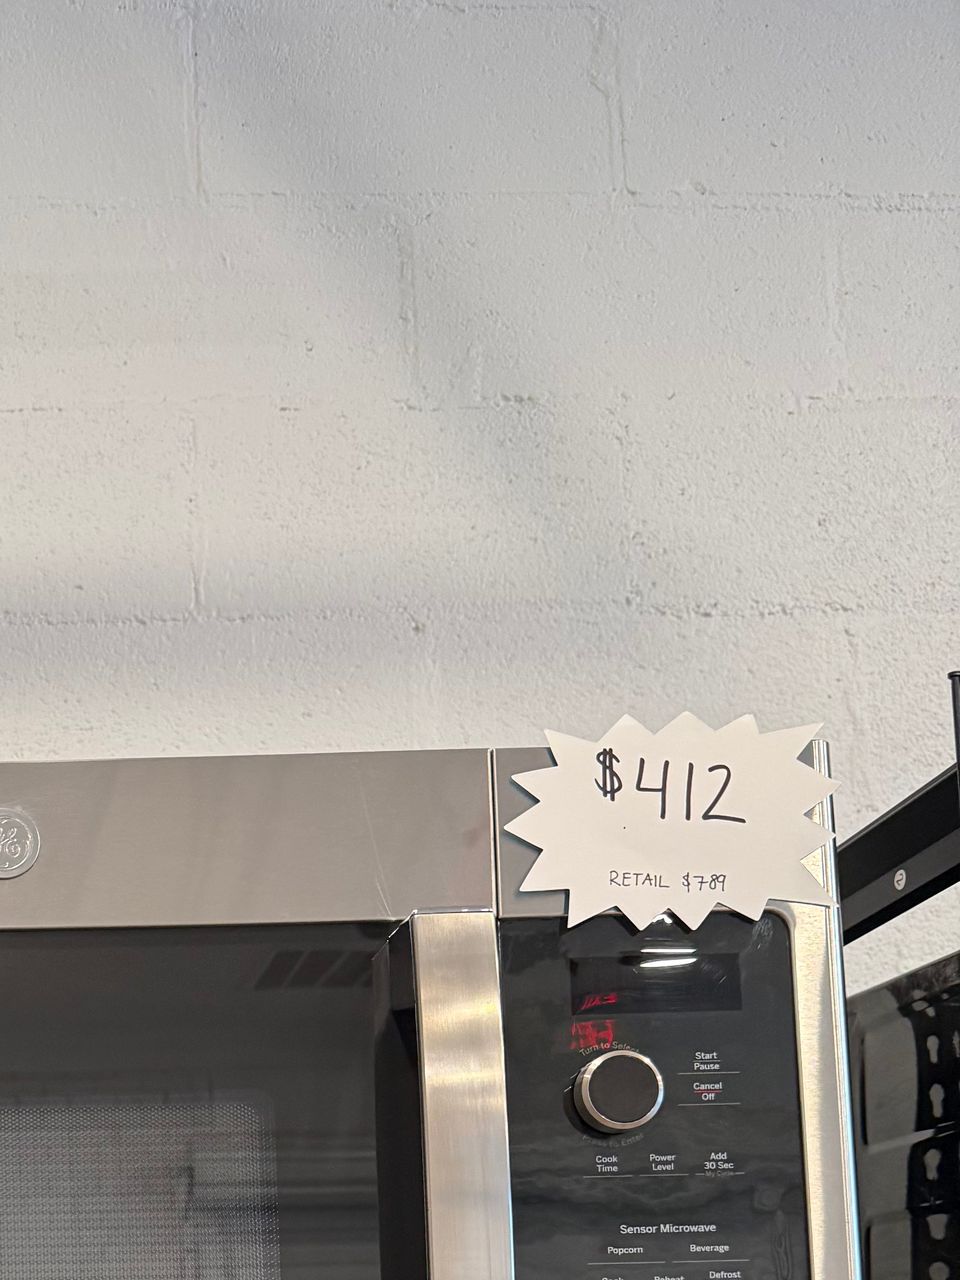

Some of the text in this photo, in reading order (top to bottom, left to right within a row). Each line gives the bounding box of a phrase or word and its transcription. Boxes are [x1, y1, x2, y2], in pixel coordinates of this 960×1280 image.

[594, 747, 747, 823] $412
[609, 870, 727, 893] RETAIL $789
[600, 1041, 610, 1049] to
[695, 1051, 718, 1060] Start
[693, 1061, 721, 1071] Pause
[693, 1081, 723, 1091] Cancel
[701, 1092, 716, 1101] Off
[595, 1155, 618, 1164] Cook
[649, 1154, 676, 1163] Power
[710, 1152, 728, 1161] Add
[596, 1164, 619, 1173] Time
[652, 1163, 675, 1171] Level
[704, 1161, 735, 1170] 30 Sec
[619, 1223, 717, 1234] Sensor Microwave
[607, 1246, 644, 1256] Popcorn
[689, 1244, 730, 1254] Beverage
[709, 1271, 742, 1280] Defrost
